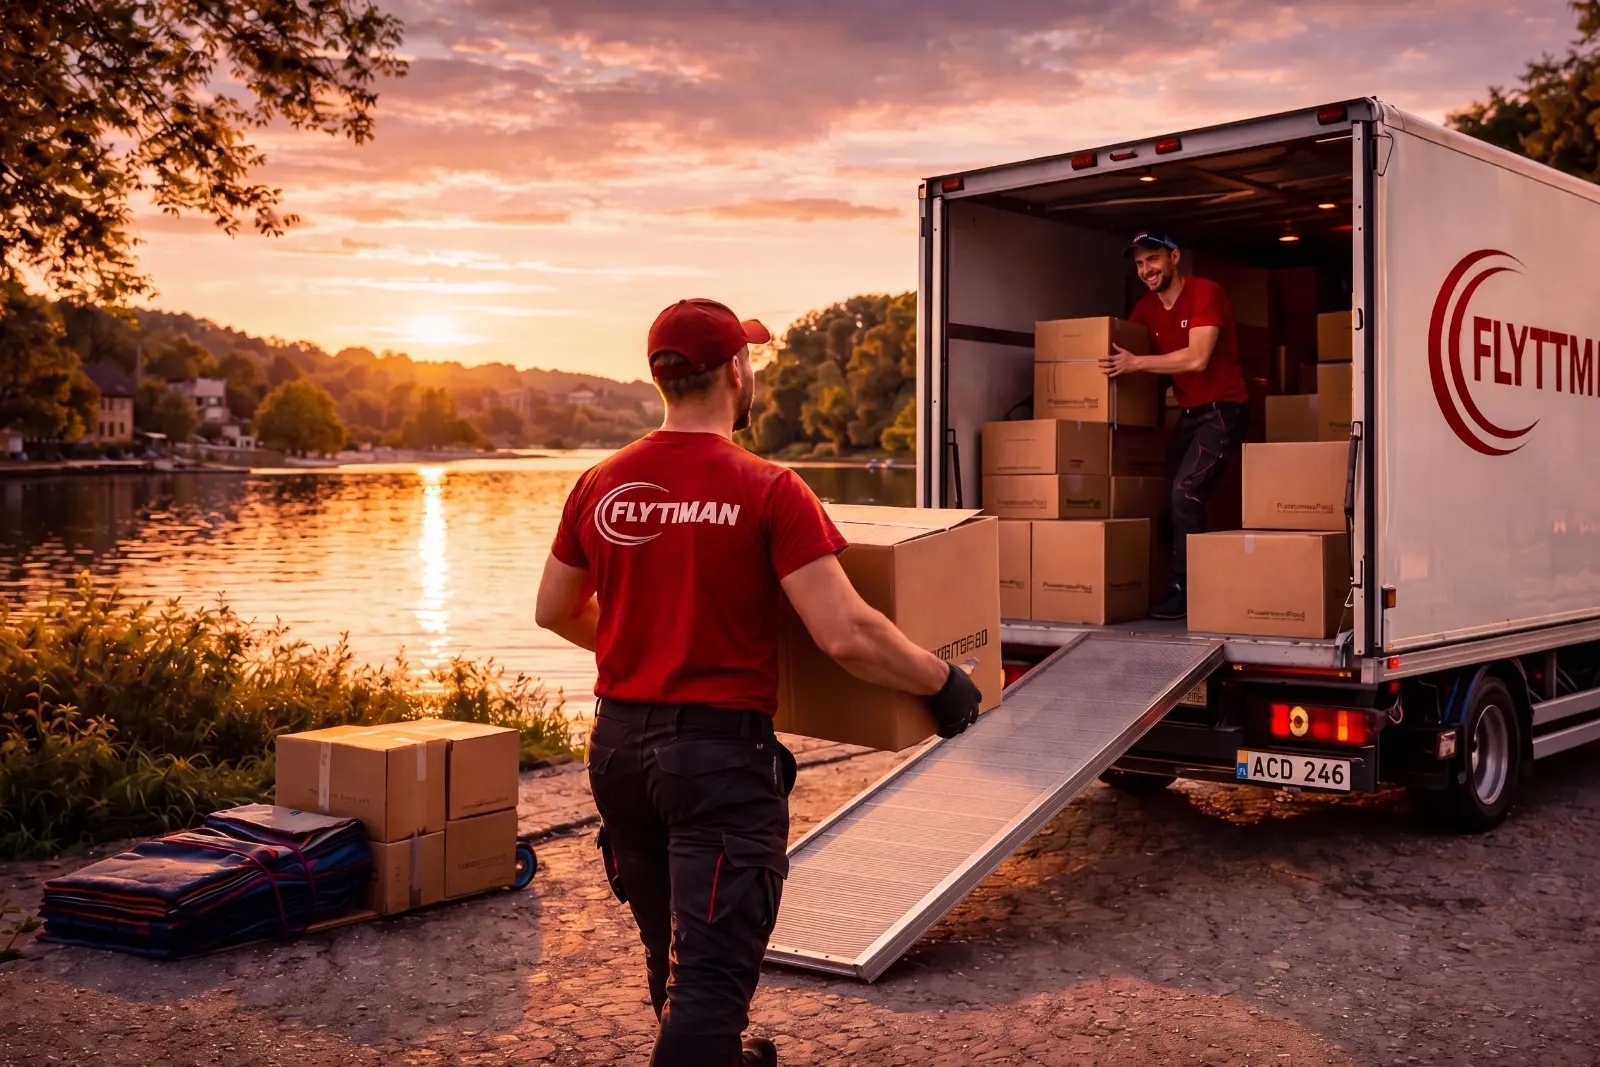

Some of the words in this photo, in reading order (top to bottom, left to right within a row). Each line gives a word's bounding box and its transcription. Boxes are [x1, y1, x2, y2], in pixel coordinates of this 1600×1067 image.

[1473, 315, 1600, 398] FLYTTM
[1252, 756, 1293, 780] ACD
[1303, 760, 1345, 785] 246
